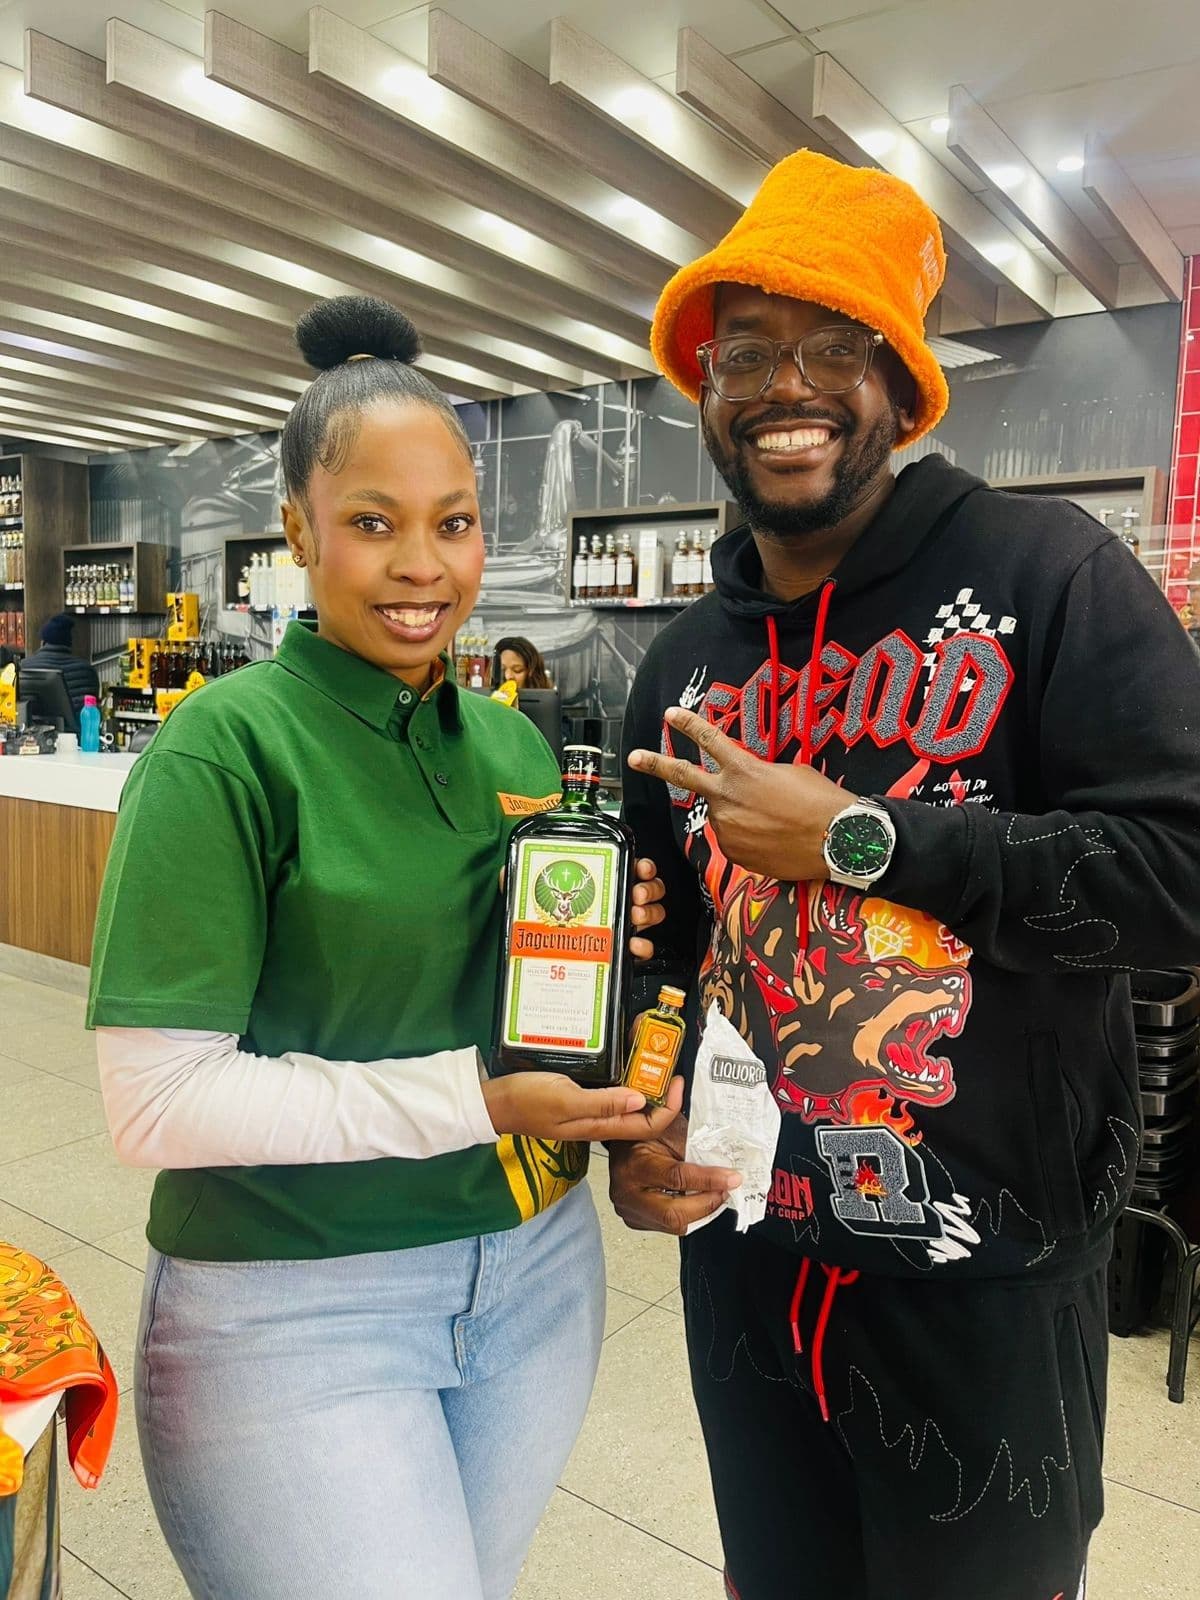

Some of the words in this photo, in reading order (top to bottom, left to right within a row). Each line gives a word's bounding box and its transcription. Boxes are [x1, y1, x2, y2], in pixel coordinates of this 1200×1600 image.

[549, 964, 567, 982] 56
[767, 1167, 814, 1217] ON
[816, 1126, 930, 1227] R
